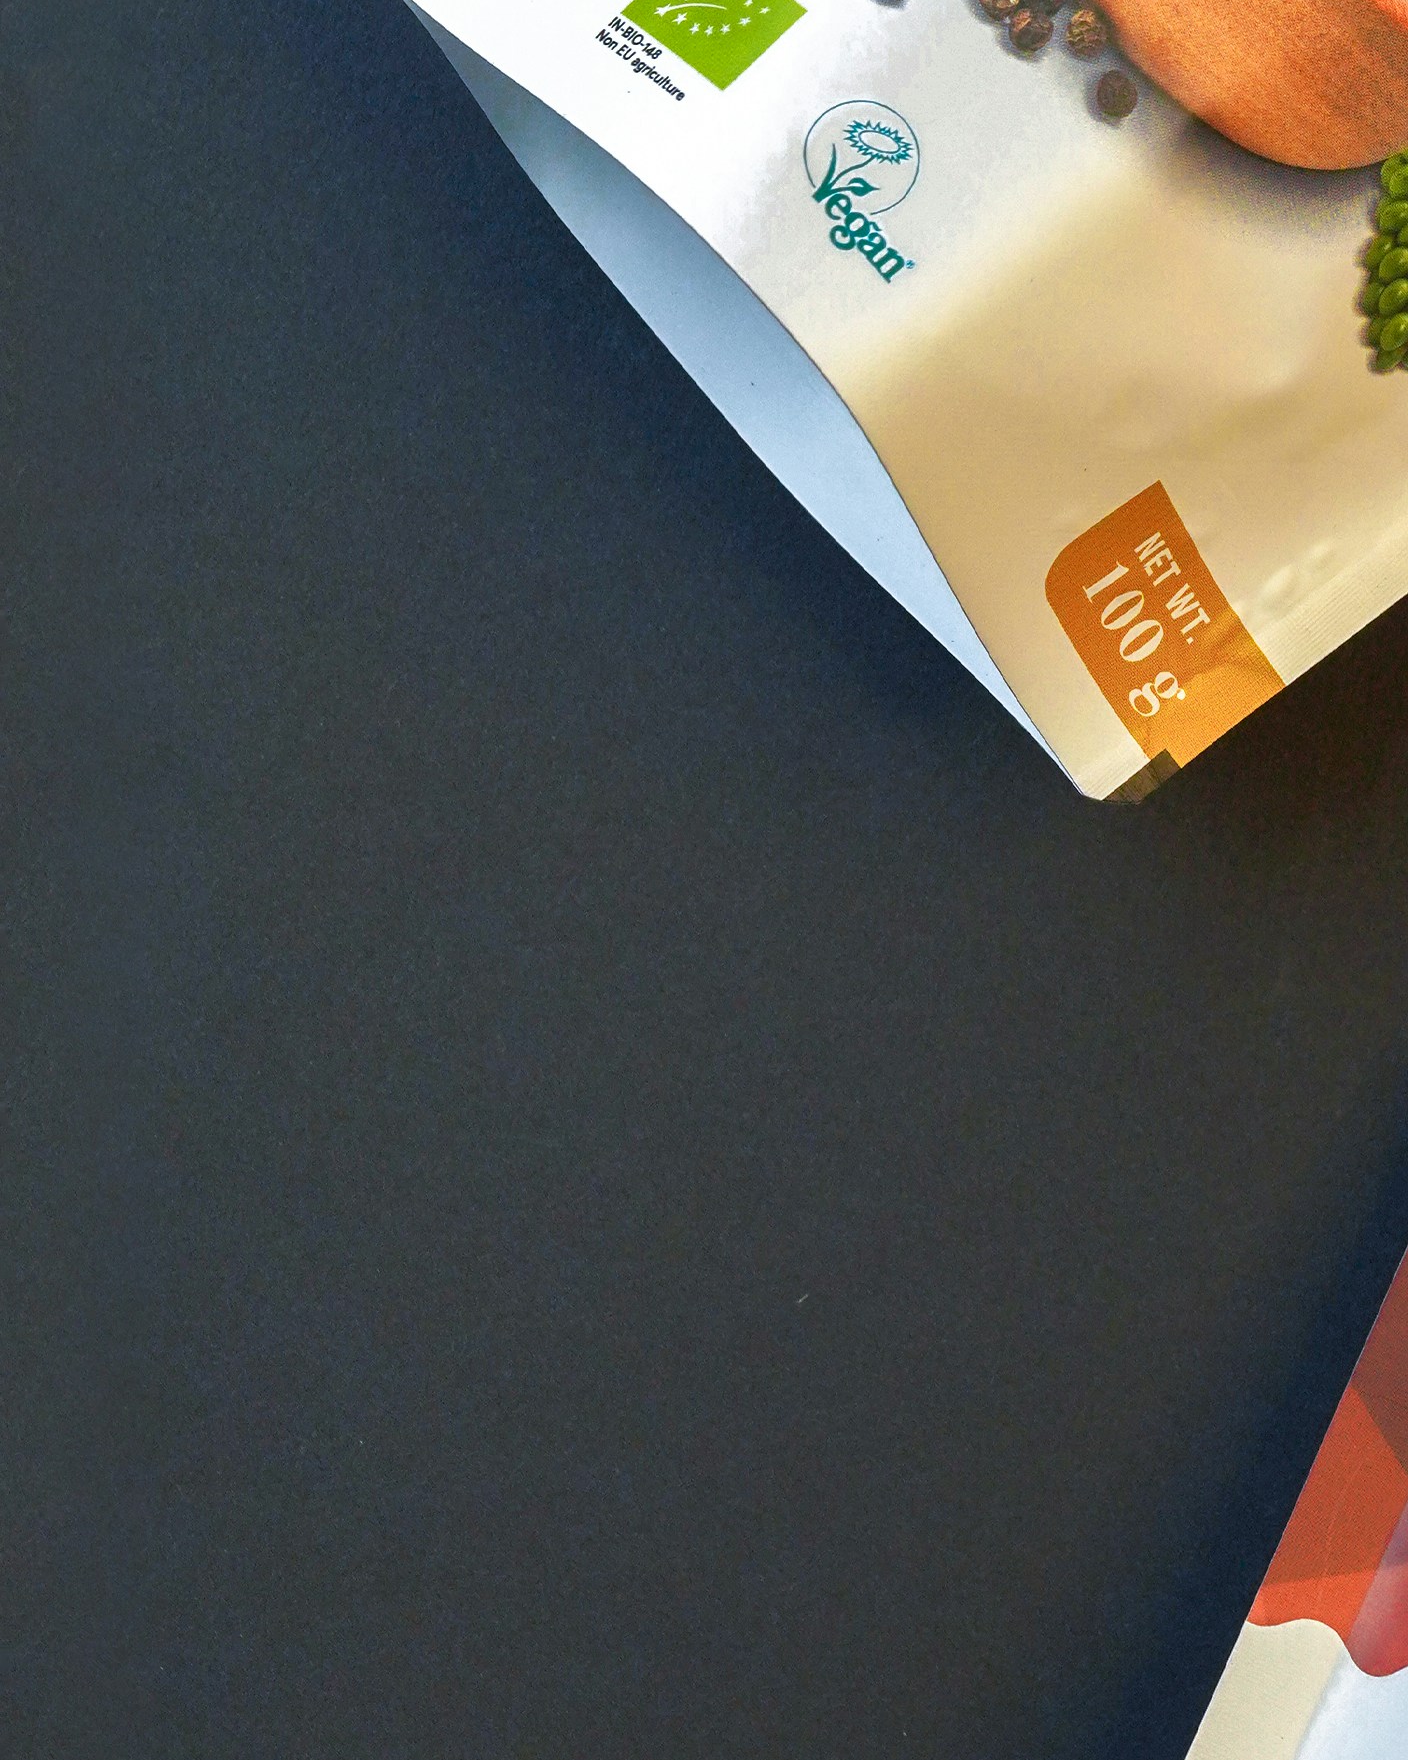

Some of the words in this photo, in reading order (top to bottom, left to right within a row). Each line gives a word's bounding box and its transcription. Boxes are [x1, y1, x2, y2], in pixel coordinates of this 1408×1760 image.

[595, 29, 618, 50] Non
[616, 44, 636, 60] EU
[631, 58, 685, 101] agriculture
[608, 16, 662, 59] IN-BIO-148
[1134, 531, 1181, 587] NET
[1165, 583, 1211, 645] WT.
[1082, 561, 1164, 662] 100
[1128, 671, 1186, 717] g
